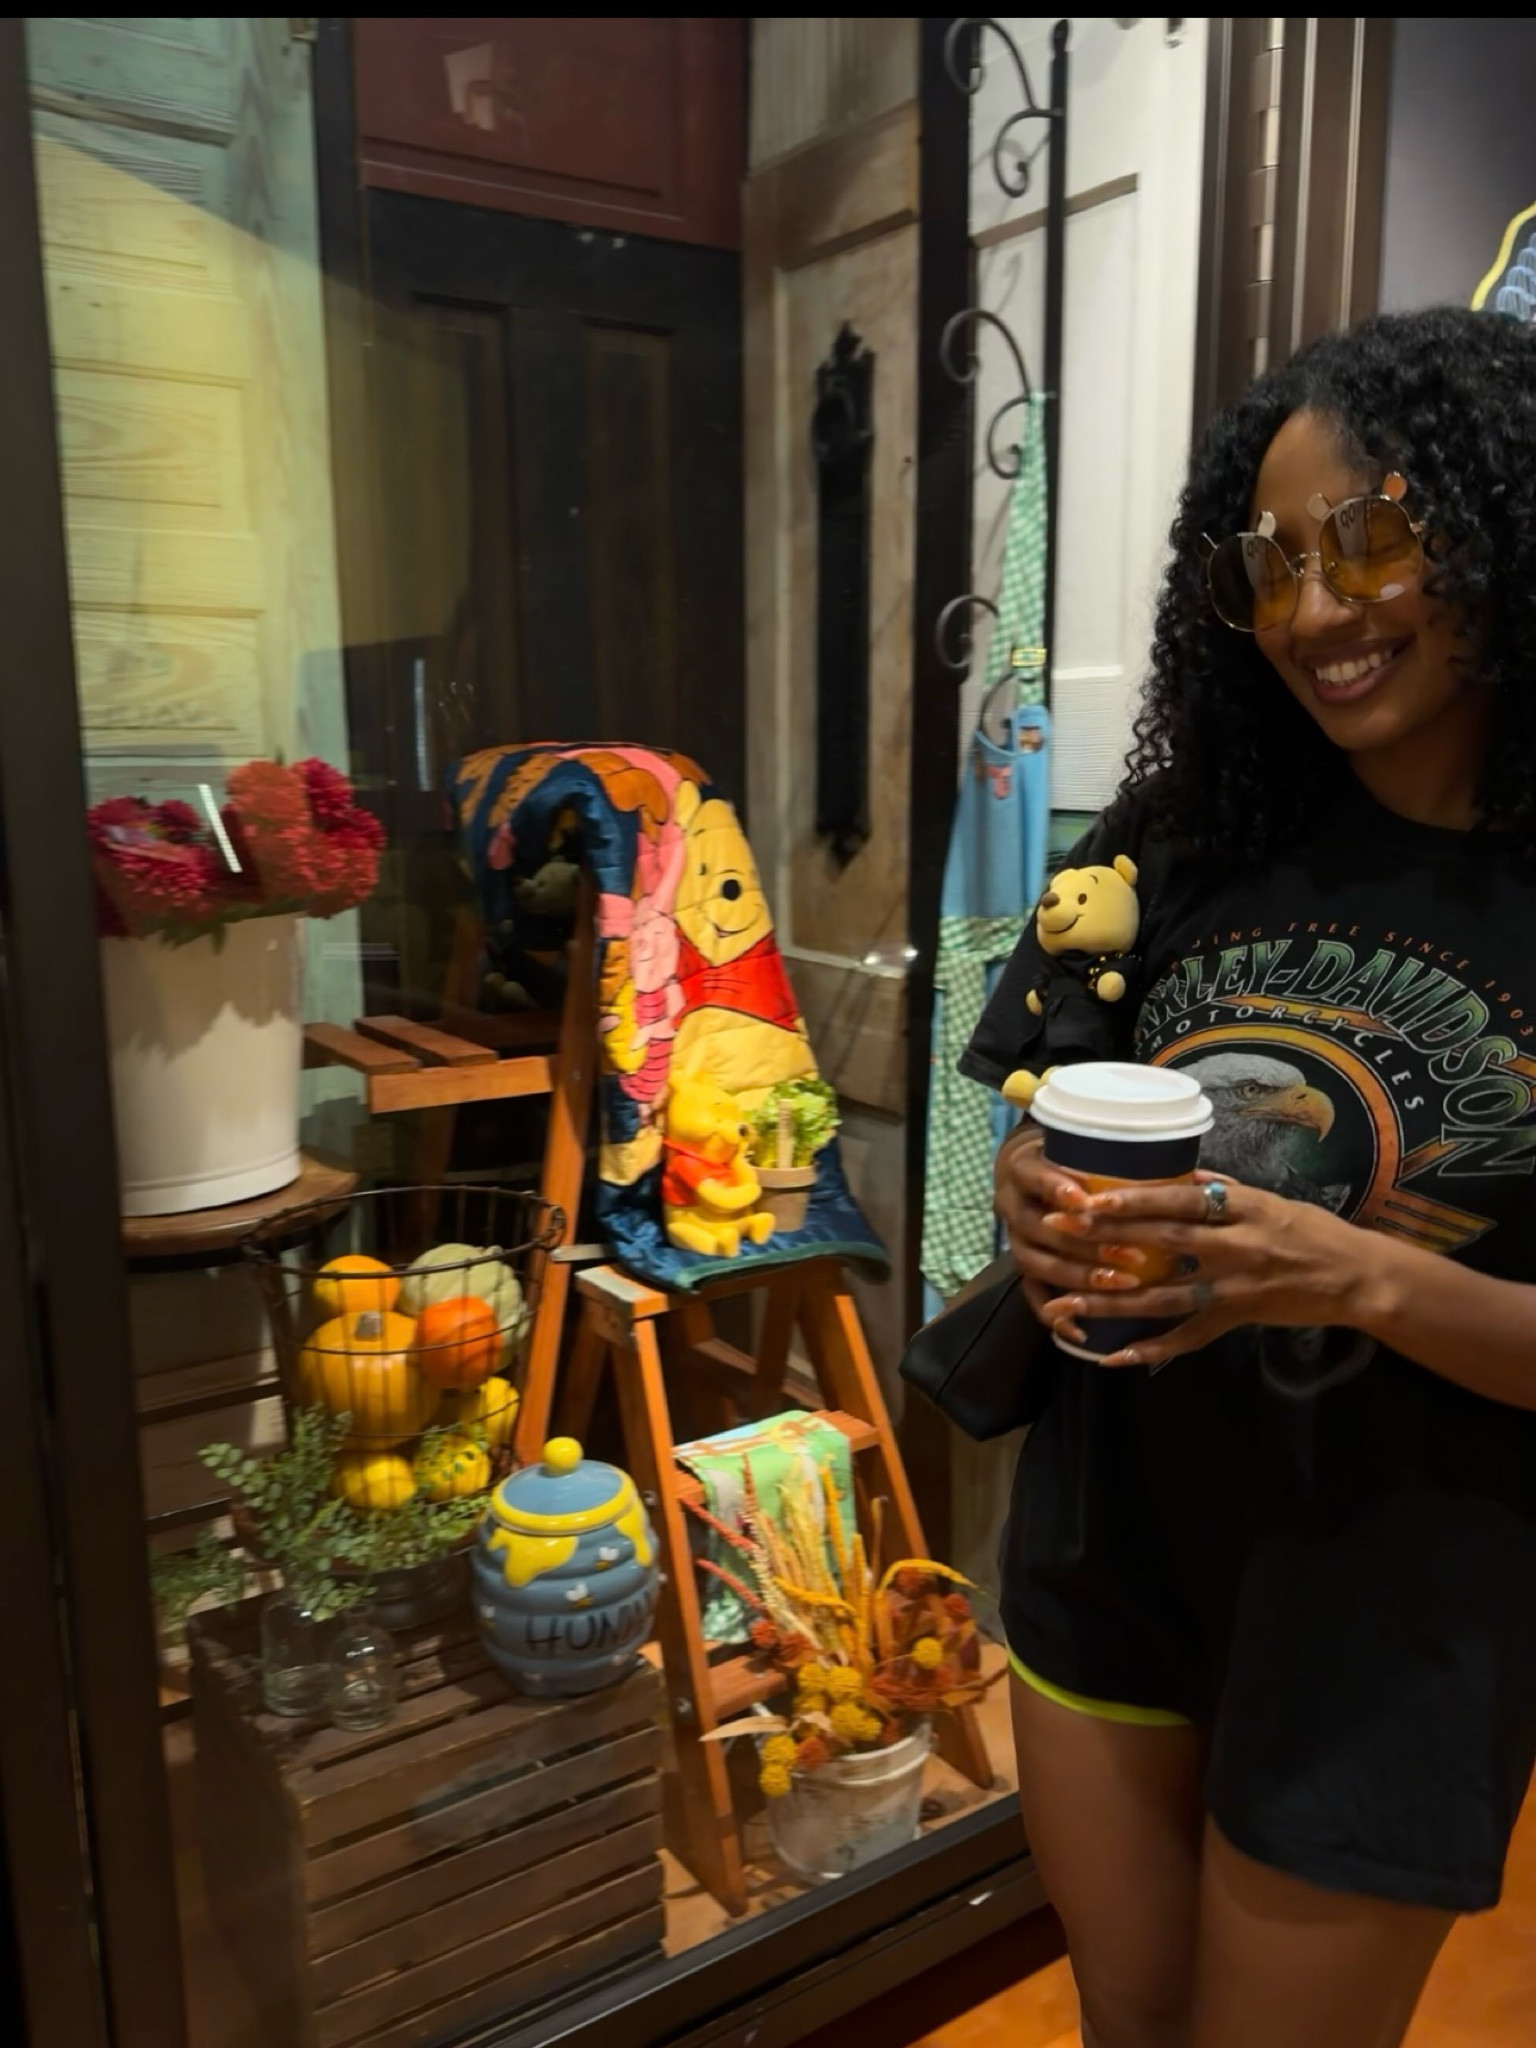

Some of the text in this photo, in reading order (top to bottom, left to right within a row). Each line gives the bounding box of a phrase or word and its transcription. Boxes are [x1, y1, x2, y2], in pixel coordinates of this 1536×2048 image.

[1287, 922, 1360, 937] FREE
[1386, 931, 1470, 971] SINCE
[1484, 978, 1534, 1037] 1903
